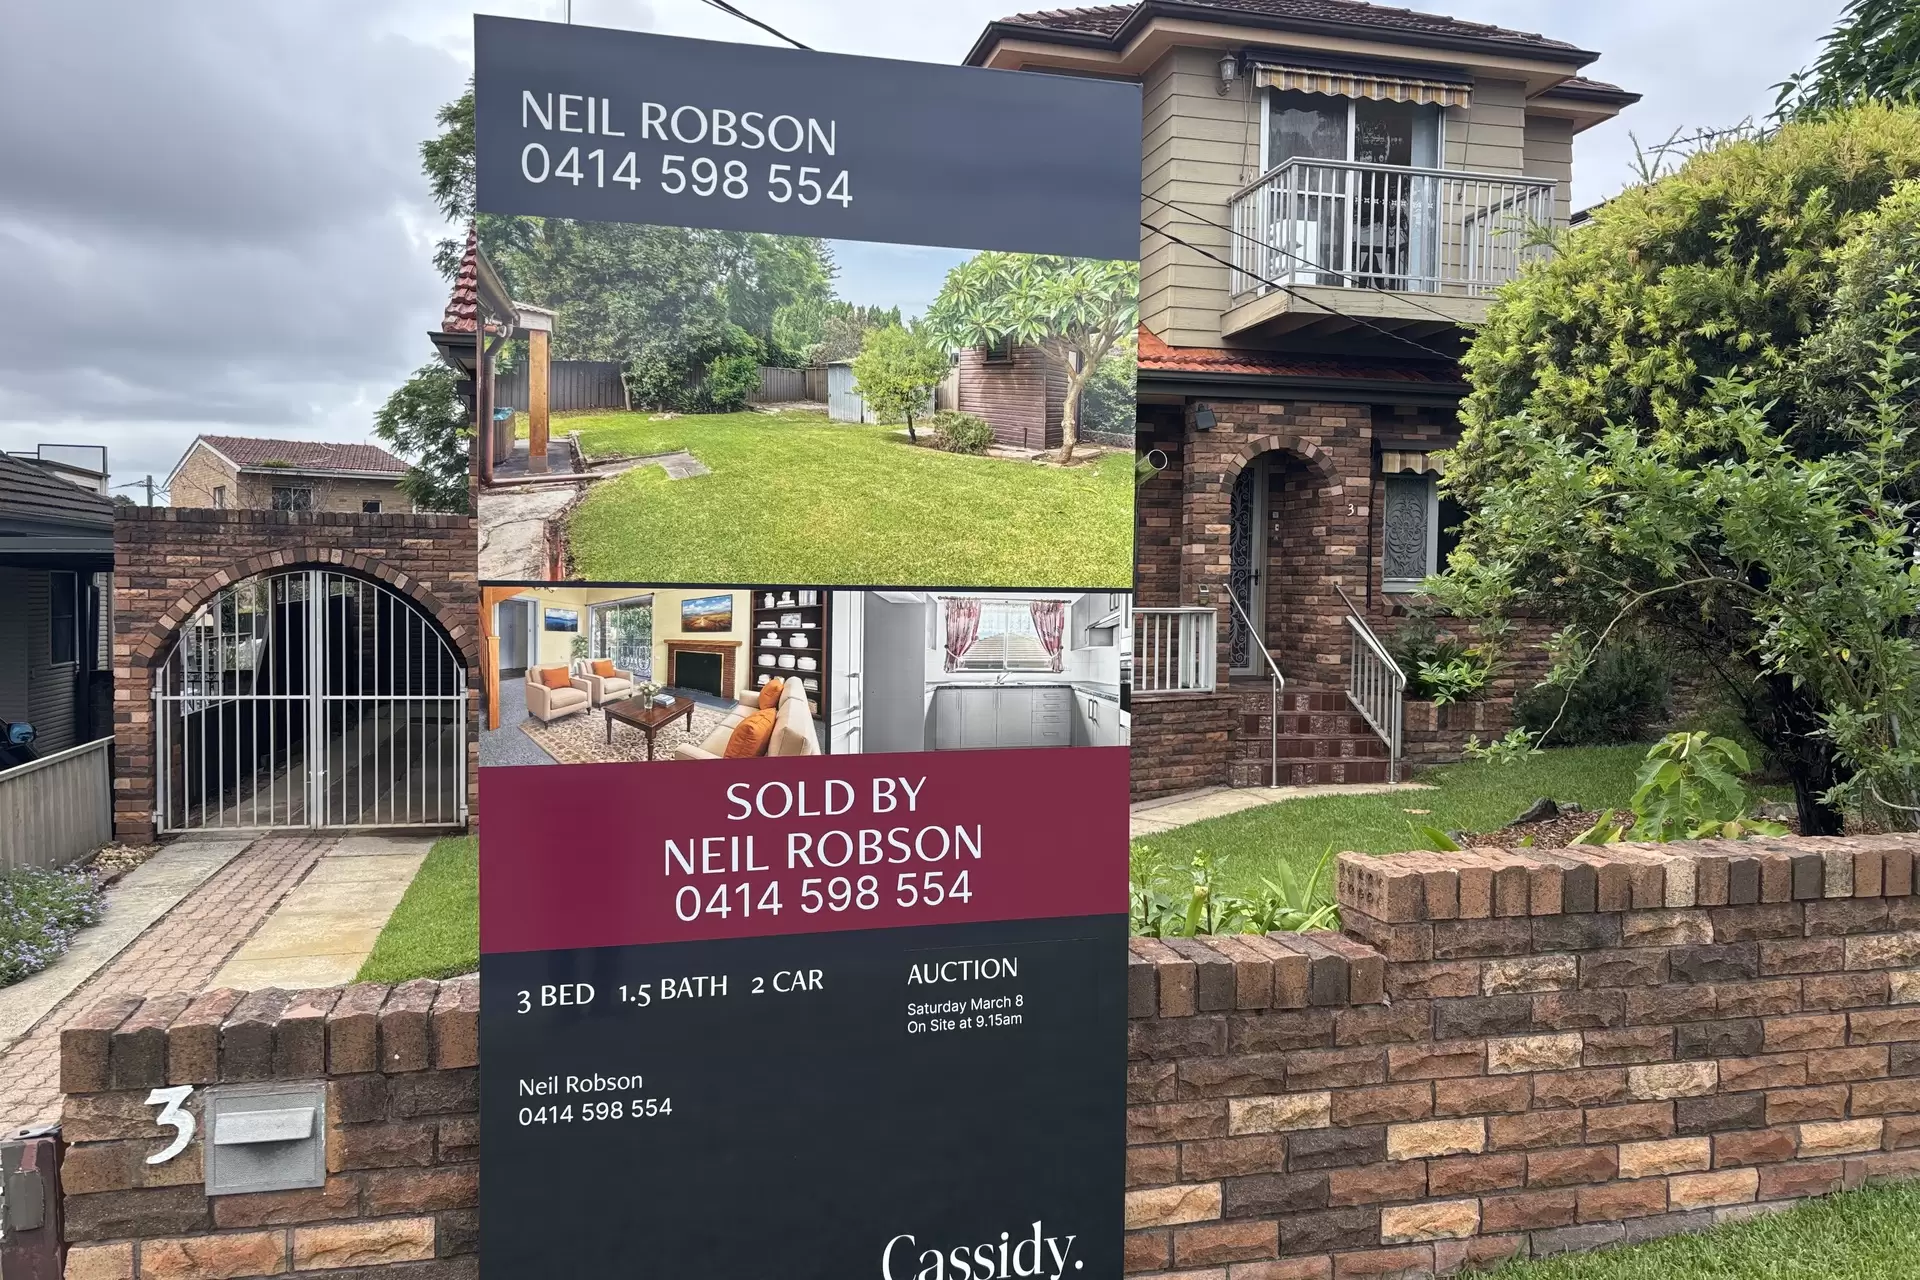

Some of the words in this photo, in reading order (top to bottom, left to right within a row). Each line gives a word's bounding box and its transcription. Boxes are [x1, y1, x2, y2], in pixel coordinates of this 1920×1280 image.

[522, 90, 626, 137] NEIL
[642, 102, 836, 157] ROBSON
[521, 142, 641, 191] 0414
[660, 154, 749, 200] 598
[768, 163, 853, 208] 554
[1347, 503, 1355, 516] 3
[726, 779, 855, 821] SOLD
[872, 776, 927, 813] BY
[665, 835, 770, 876] NEIL
[787, 824, 982, 869] ROBSON
[675, 880, 783, 922] 0414
[800, 874, 879, 914] 598
[896, 869, 973, 908] 554
[517, 990, 532, 1014] 3
[541, 983, 595, 1007] BED
[618, 983, 651, 1007] 1.5
[660, 974, 728, 1000] BATH
[751, 976, 765, 994] 2
[772, 969, 824, 993] CAR
[907, 957, 1018, 986] AUCTION
[907, 1000, 967, 1016] Saturday
[970, 995, 1012, 1011] March
[1015, 994, 1024, 1007] 8
[907, 1020, 926, 1034] On
[930, 1018, 956, 1032] Site
[959, 1016, 972, 1030] at
[975, 1013, 1023, 1028] 9.15am
[519, 1075, 558, 1097] Neil
[566, 1072, 643, 1094] Robson
[143, 1084, 196, 1165] 3
[518, 1104, 574, 1126] 0414
[582, 1100, 624, 1122] 598
[631, 1097, 673, 1118] 554
[882, 1220, 1084, 1280] Cassidy.
